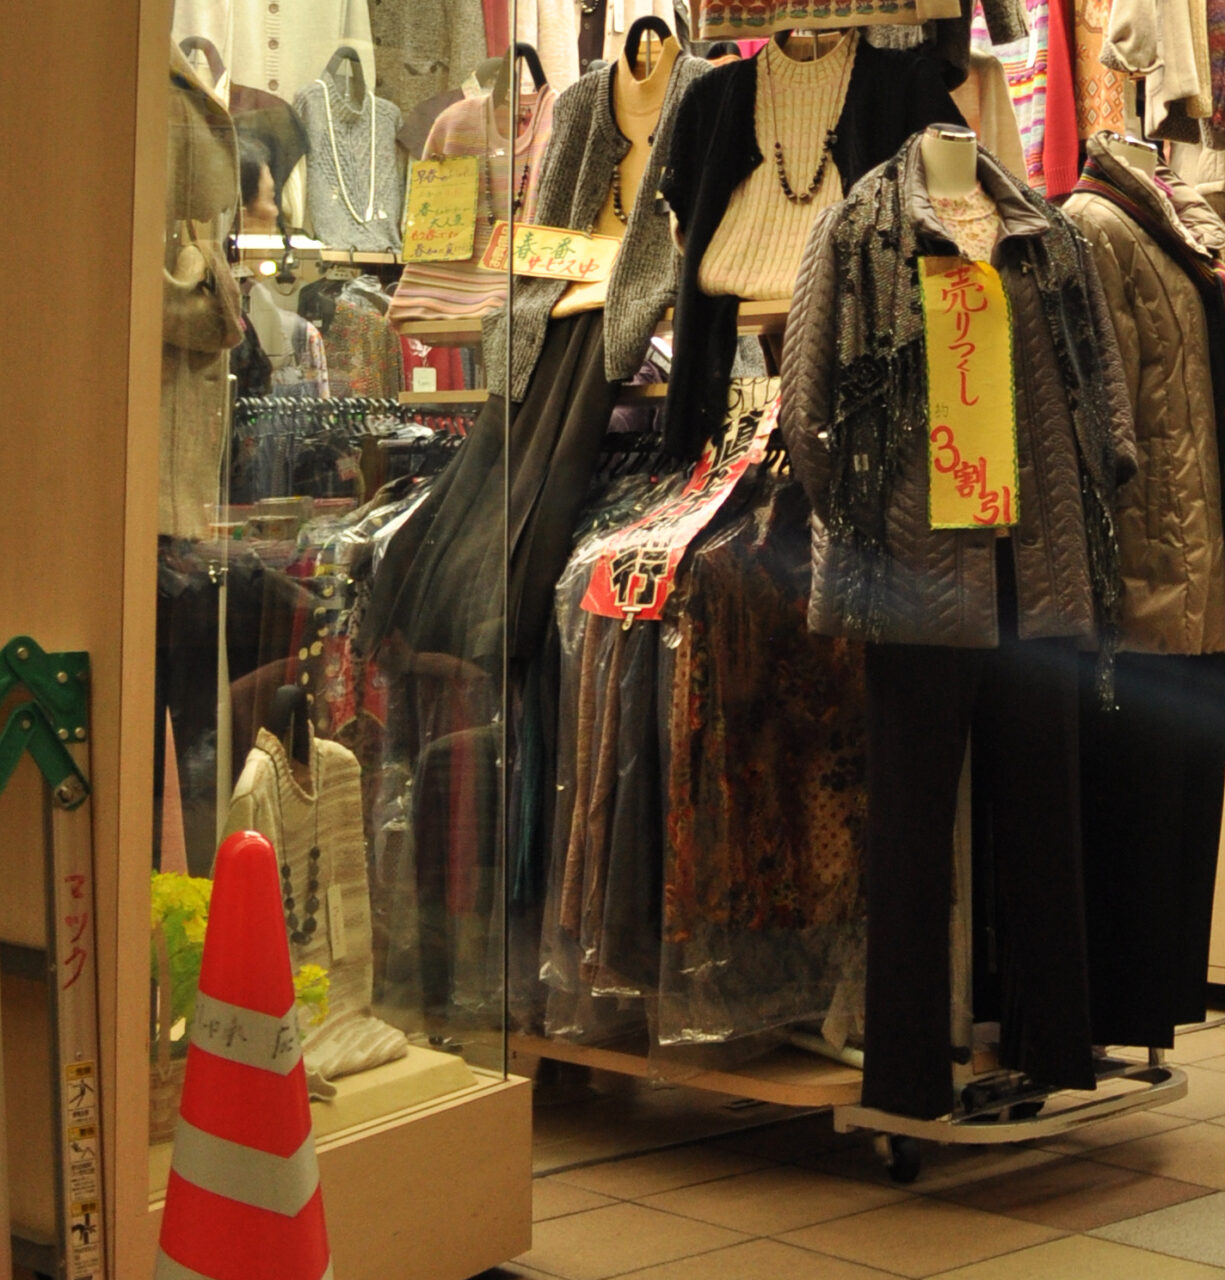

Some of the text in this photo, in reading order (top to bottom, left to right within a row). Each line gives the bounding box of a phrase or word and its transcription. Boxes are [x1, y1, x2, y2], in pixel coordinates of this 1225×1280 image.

[513, 231, 576, 261] 春一番
[941, 266, 989, 407] 売りつくし
[930, 424, 1012, 525] 3割引
[63, 874, 89, 991] マック
